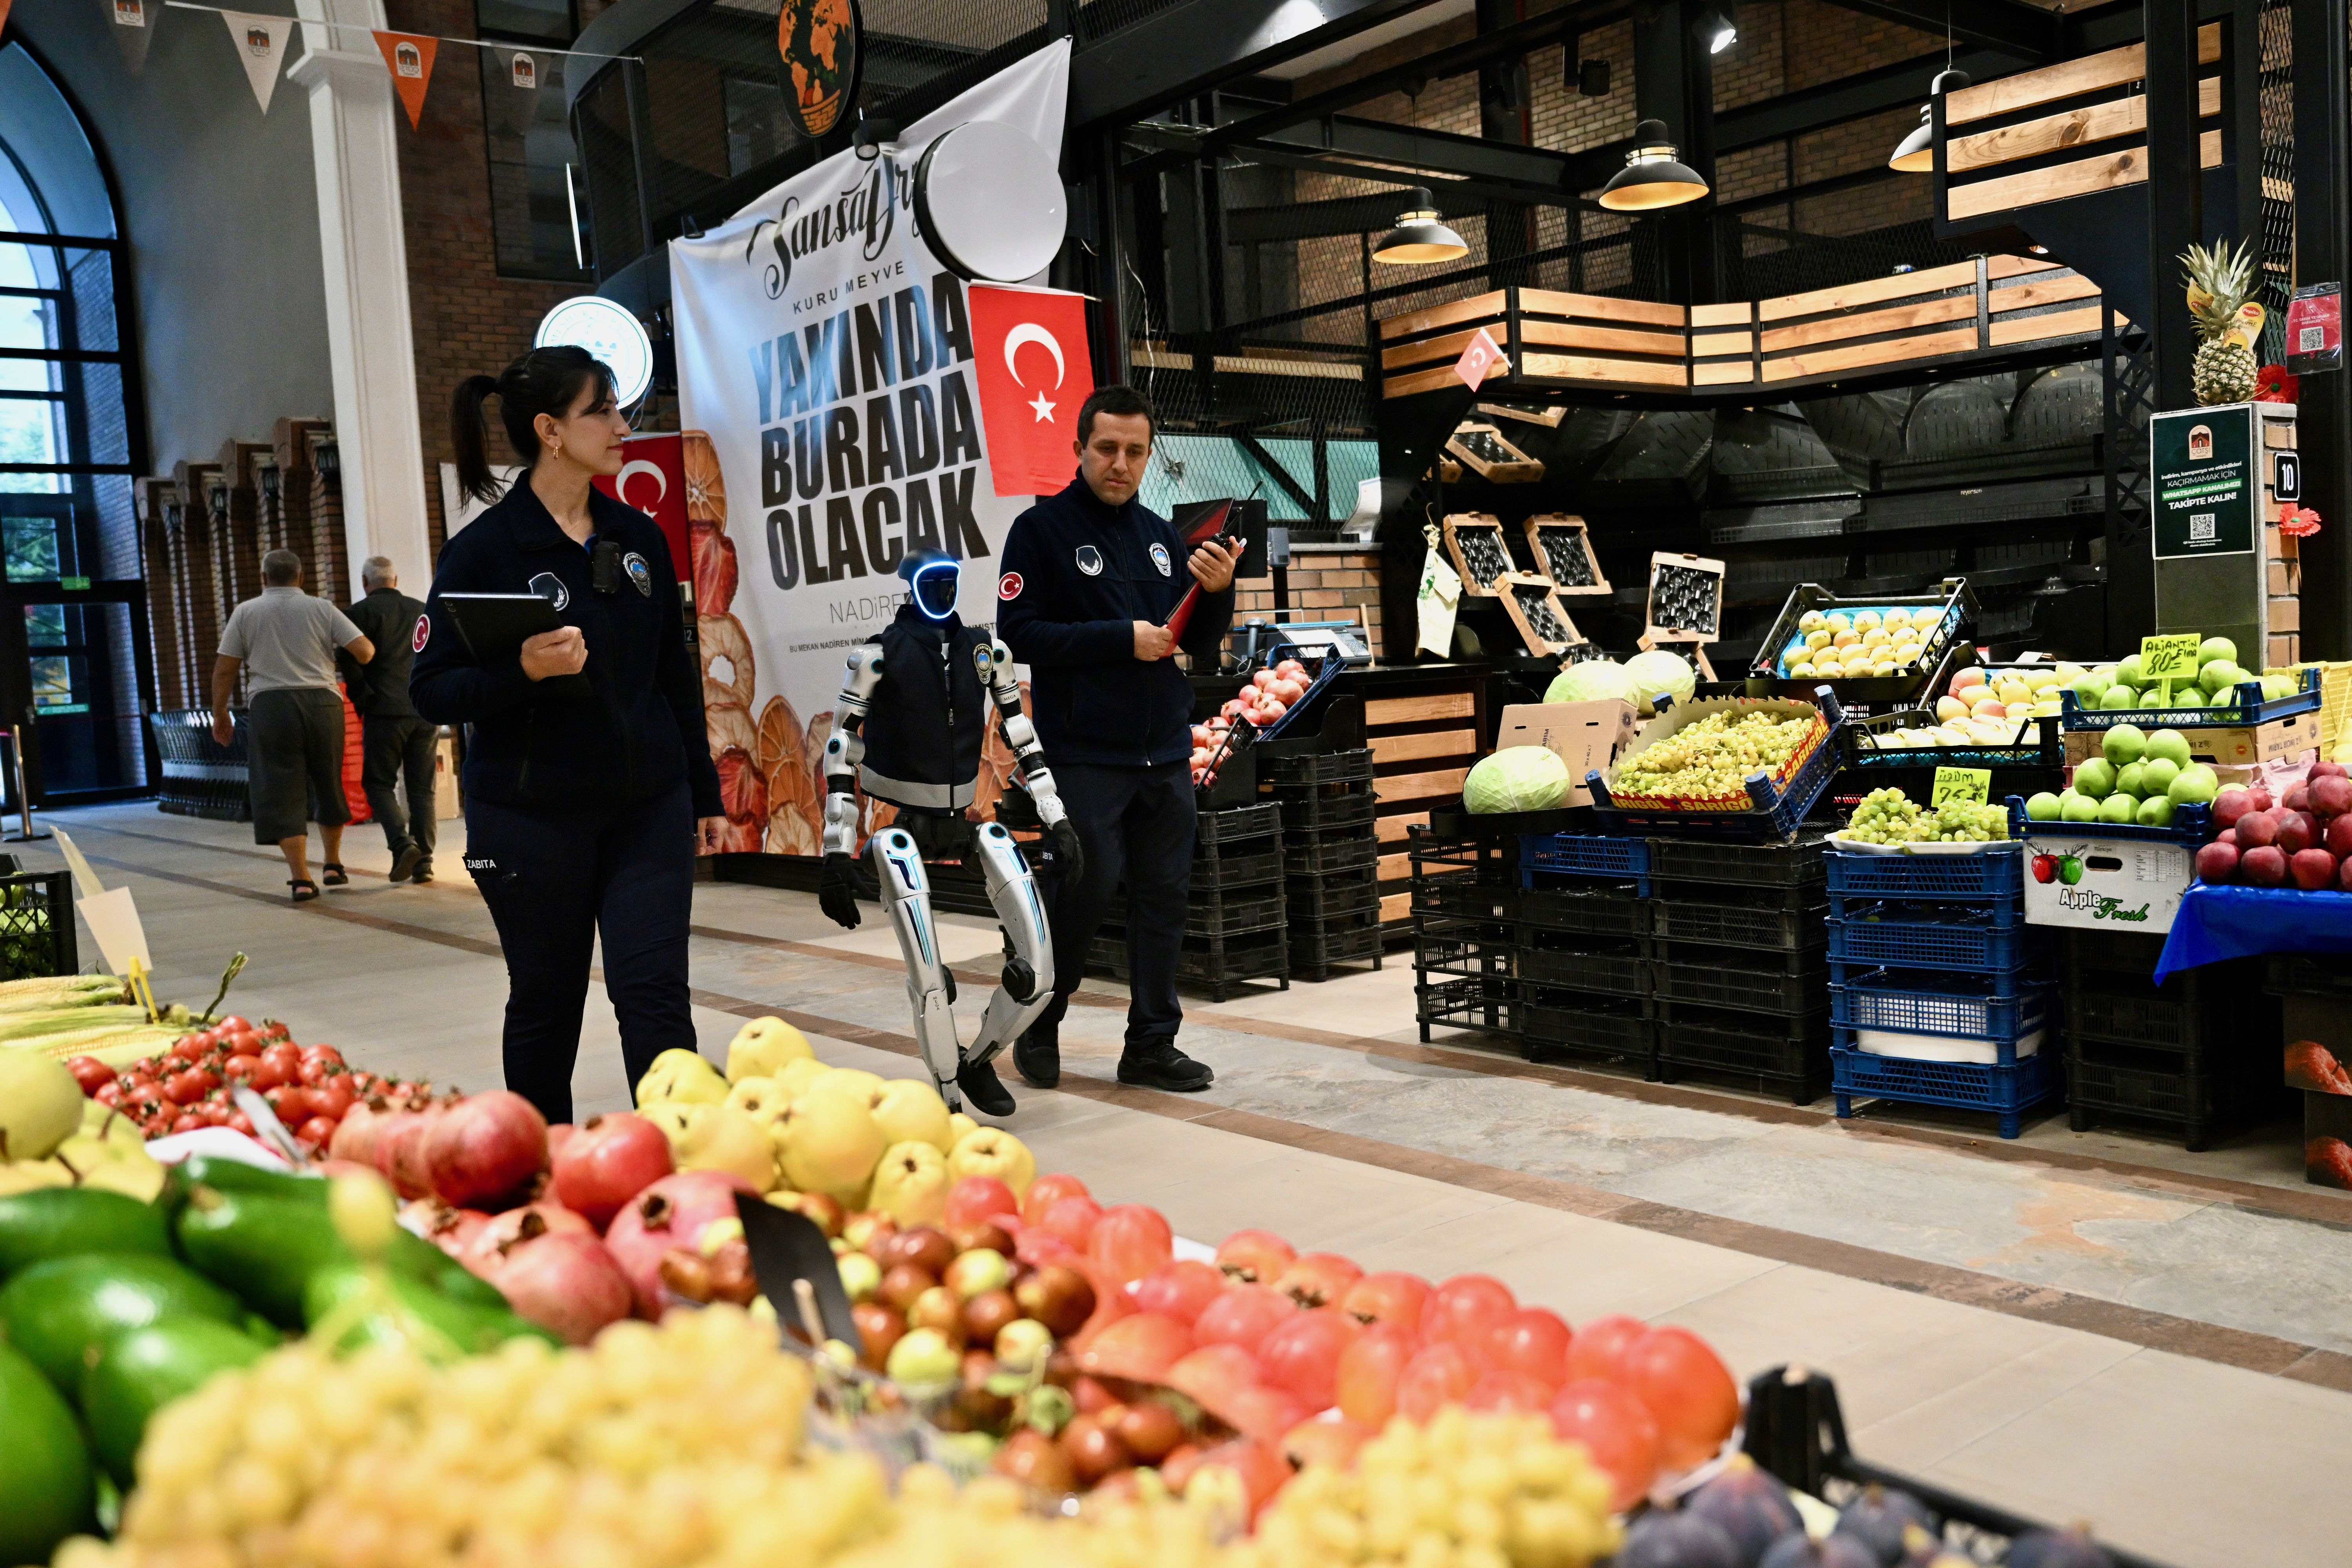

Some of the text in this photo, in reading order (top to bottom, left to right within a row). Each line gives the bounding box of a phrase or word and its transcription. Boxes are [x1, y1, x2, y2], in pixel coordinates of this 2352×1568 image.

[793, 261, 904, 314] KURU MEYVE
[748, 270, 974, 425] YAKINDA
[761, 370, 982, 509] BURADA
[2167, 470, 2236, 488] KAÇIRMAMAK İÇİN
[2181, 468, 2208, 477] kampanya
[2215, 461, 2242, 470] etkinlikleri
[2282, 464, 2294, 491] 10
[2163, 481, 2241, 499] WHATSAPP KANALIMIZI
[2168, 492, 2237, 510] TAKİPTE KALIN!
[766, 466, 991, 591] OLACAK
[799, 643, 819, 652] MEKAN
[820, 639, 849, 650] NADİREN
[851, 637, 869, 646] MİMA
[1785, 720, 1828, 784] SARIGÖL
[1611, 795, 1754, 811] ARIGÖL SARIGÖ
[466, 859, 497, 869] ZABITA
[2059, 889, 2102, 910] Apple
[2093, 897, 2150, 922] Fresh
